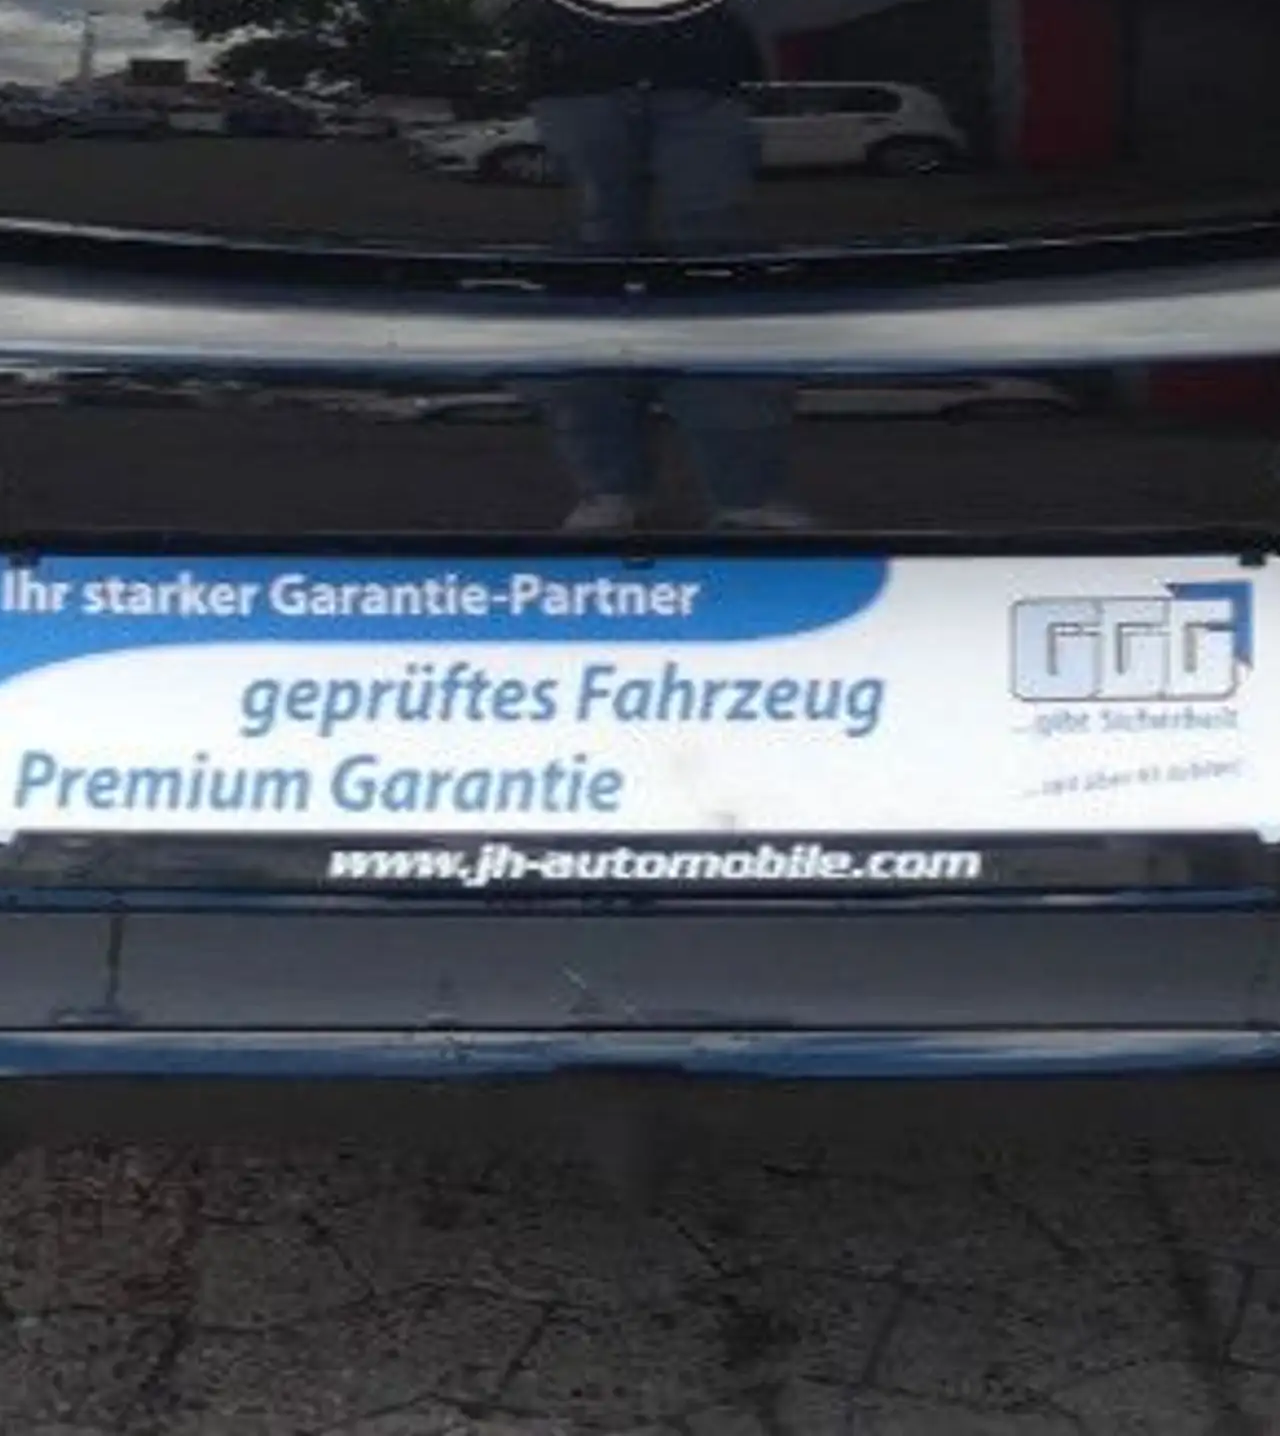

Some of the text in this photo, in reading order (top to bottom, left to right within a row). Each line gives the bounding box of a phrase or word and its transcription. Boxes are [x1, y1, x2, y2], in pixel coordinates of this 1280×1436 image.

[1, 570, 701, 617] Ihr starker Garantie-Partner
[240, 662, 885, 739] geprüftes Fahrzeug
[13, 751, 624, 814] Premium Garantie
[327, 842, 982, 887] www.jh-automobile.com
